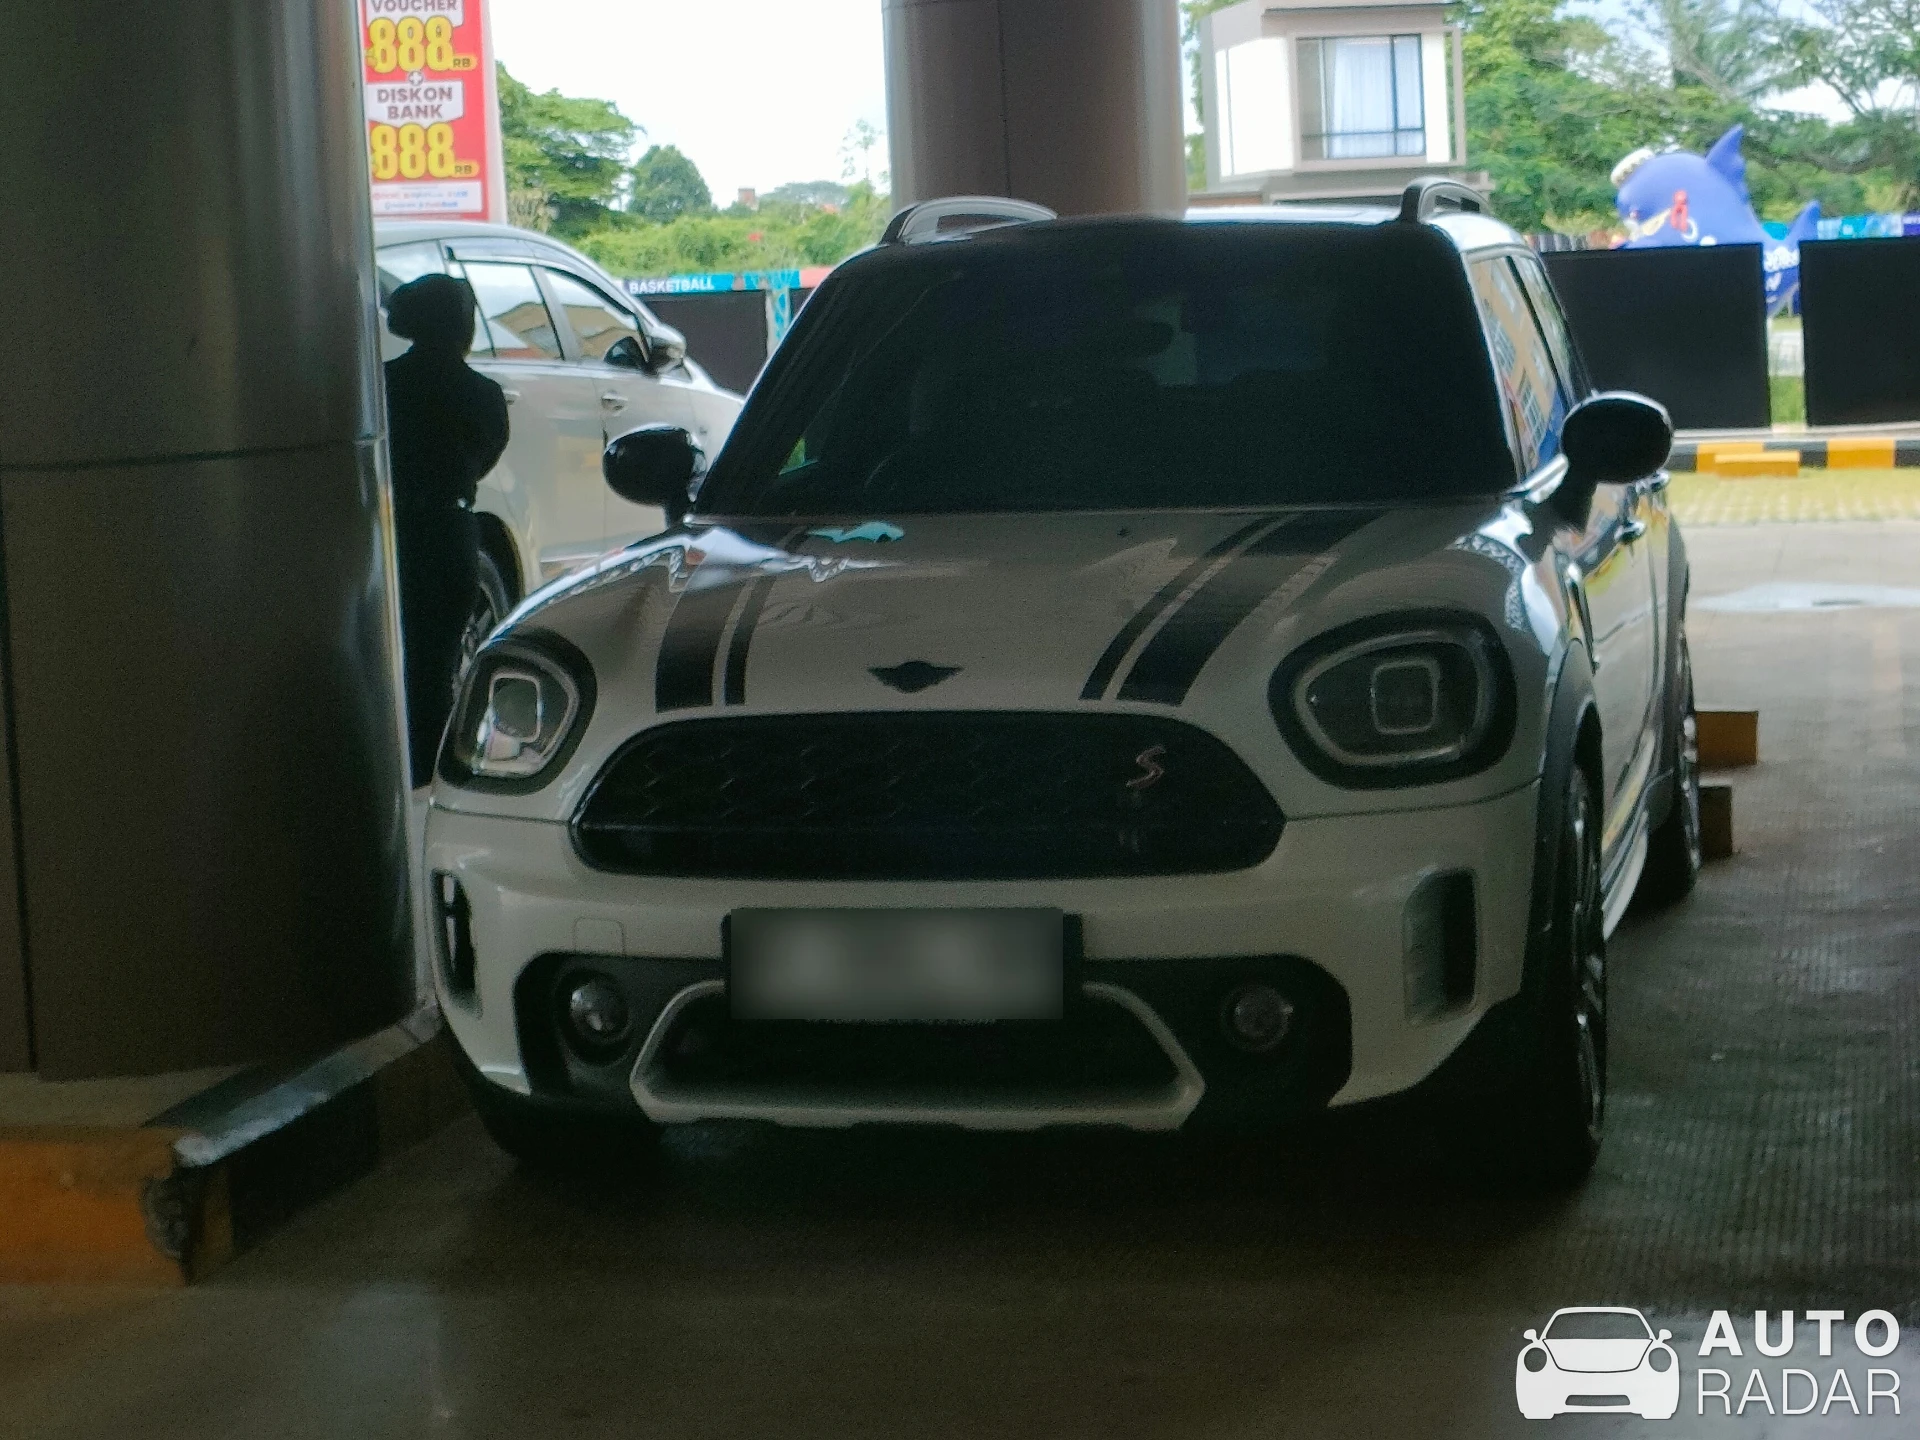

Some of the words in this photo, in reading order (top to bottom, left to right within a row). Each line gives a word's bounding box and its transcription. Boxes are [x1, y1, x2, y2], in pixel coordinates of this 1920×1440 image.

[371, 0, 457, 12] VOUCHER
[369, 15, 454, 73] 888
[377, 87, 453, 103] DISKON
[387, 104, 443, 119] BANK
[370, 122, 455, 179] 888
[629, 277, 714, 293] BASKETBALL
